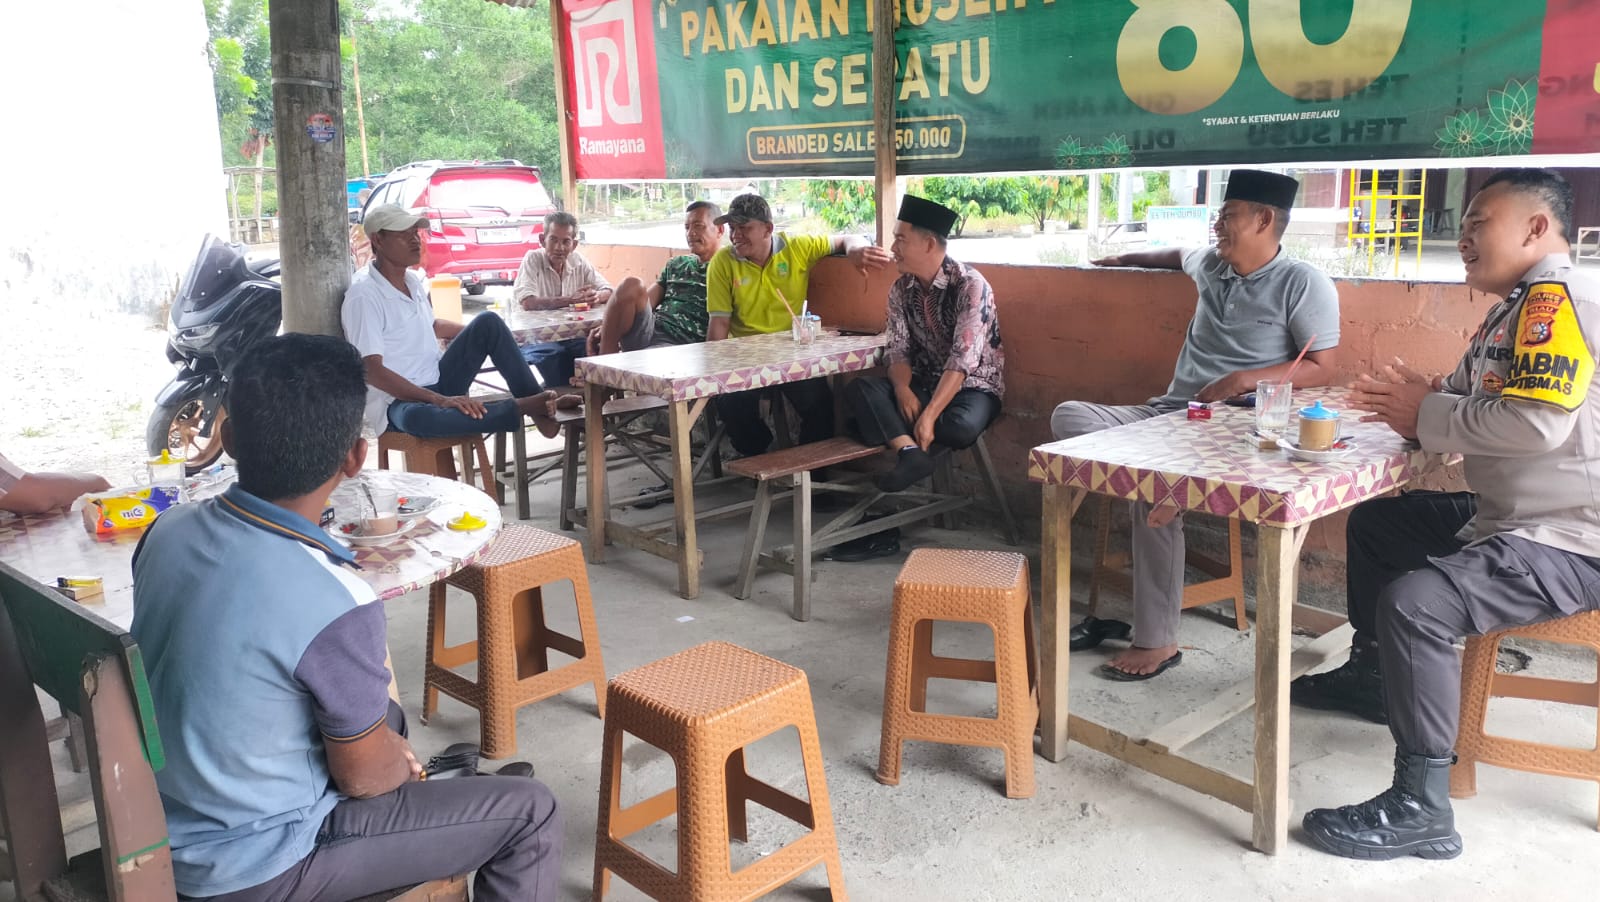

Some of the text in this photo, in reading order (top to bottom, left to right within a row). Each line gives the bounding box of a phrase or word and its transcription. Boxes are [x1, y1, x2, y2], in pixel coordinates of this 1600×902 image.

[681, 0, 850, 57] PAKAIAN
[725, 36, 991, 114] DAN SEATU
[1241, 115, 1248, 124] &
[1249, 111, 1299, 123] KETENTUAN
[1300, 109, 1341, 120] BERLAKU
[578, 136, 646, 158] Ramayana
[756, 133, 828, 155] BRANDED
[833, 131, 876, 152] SALE
